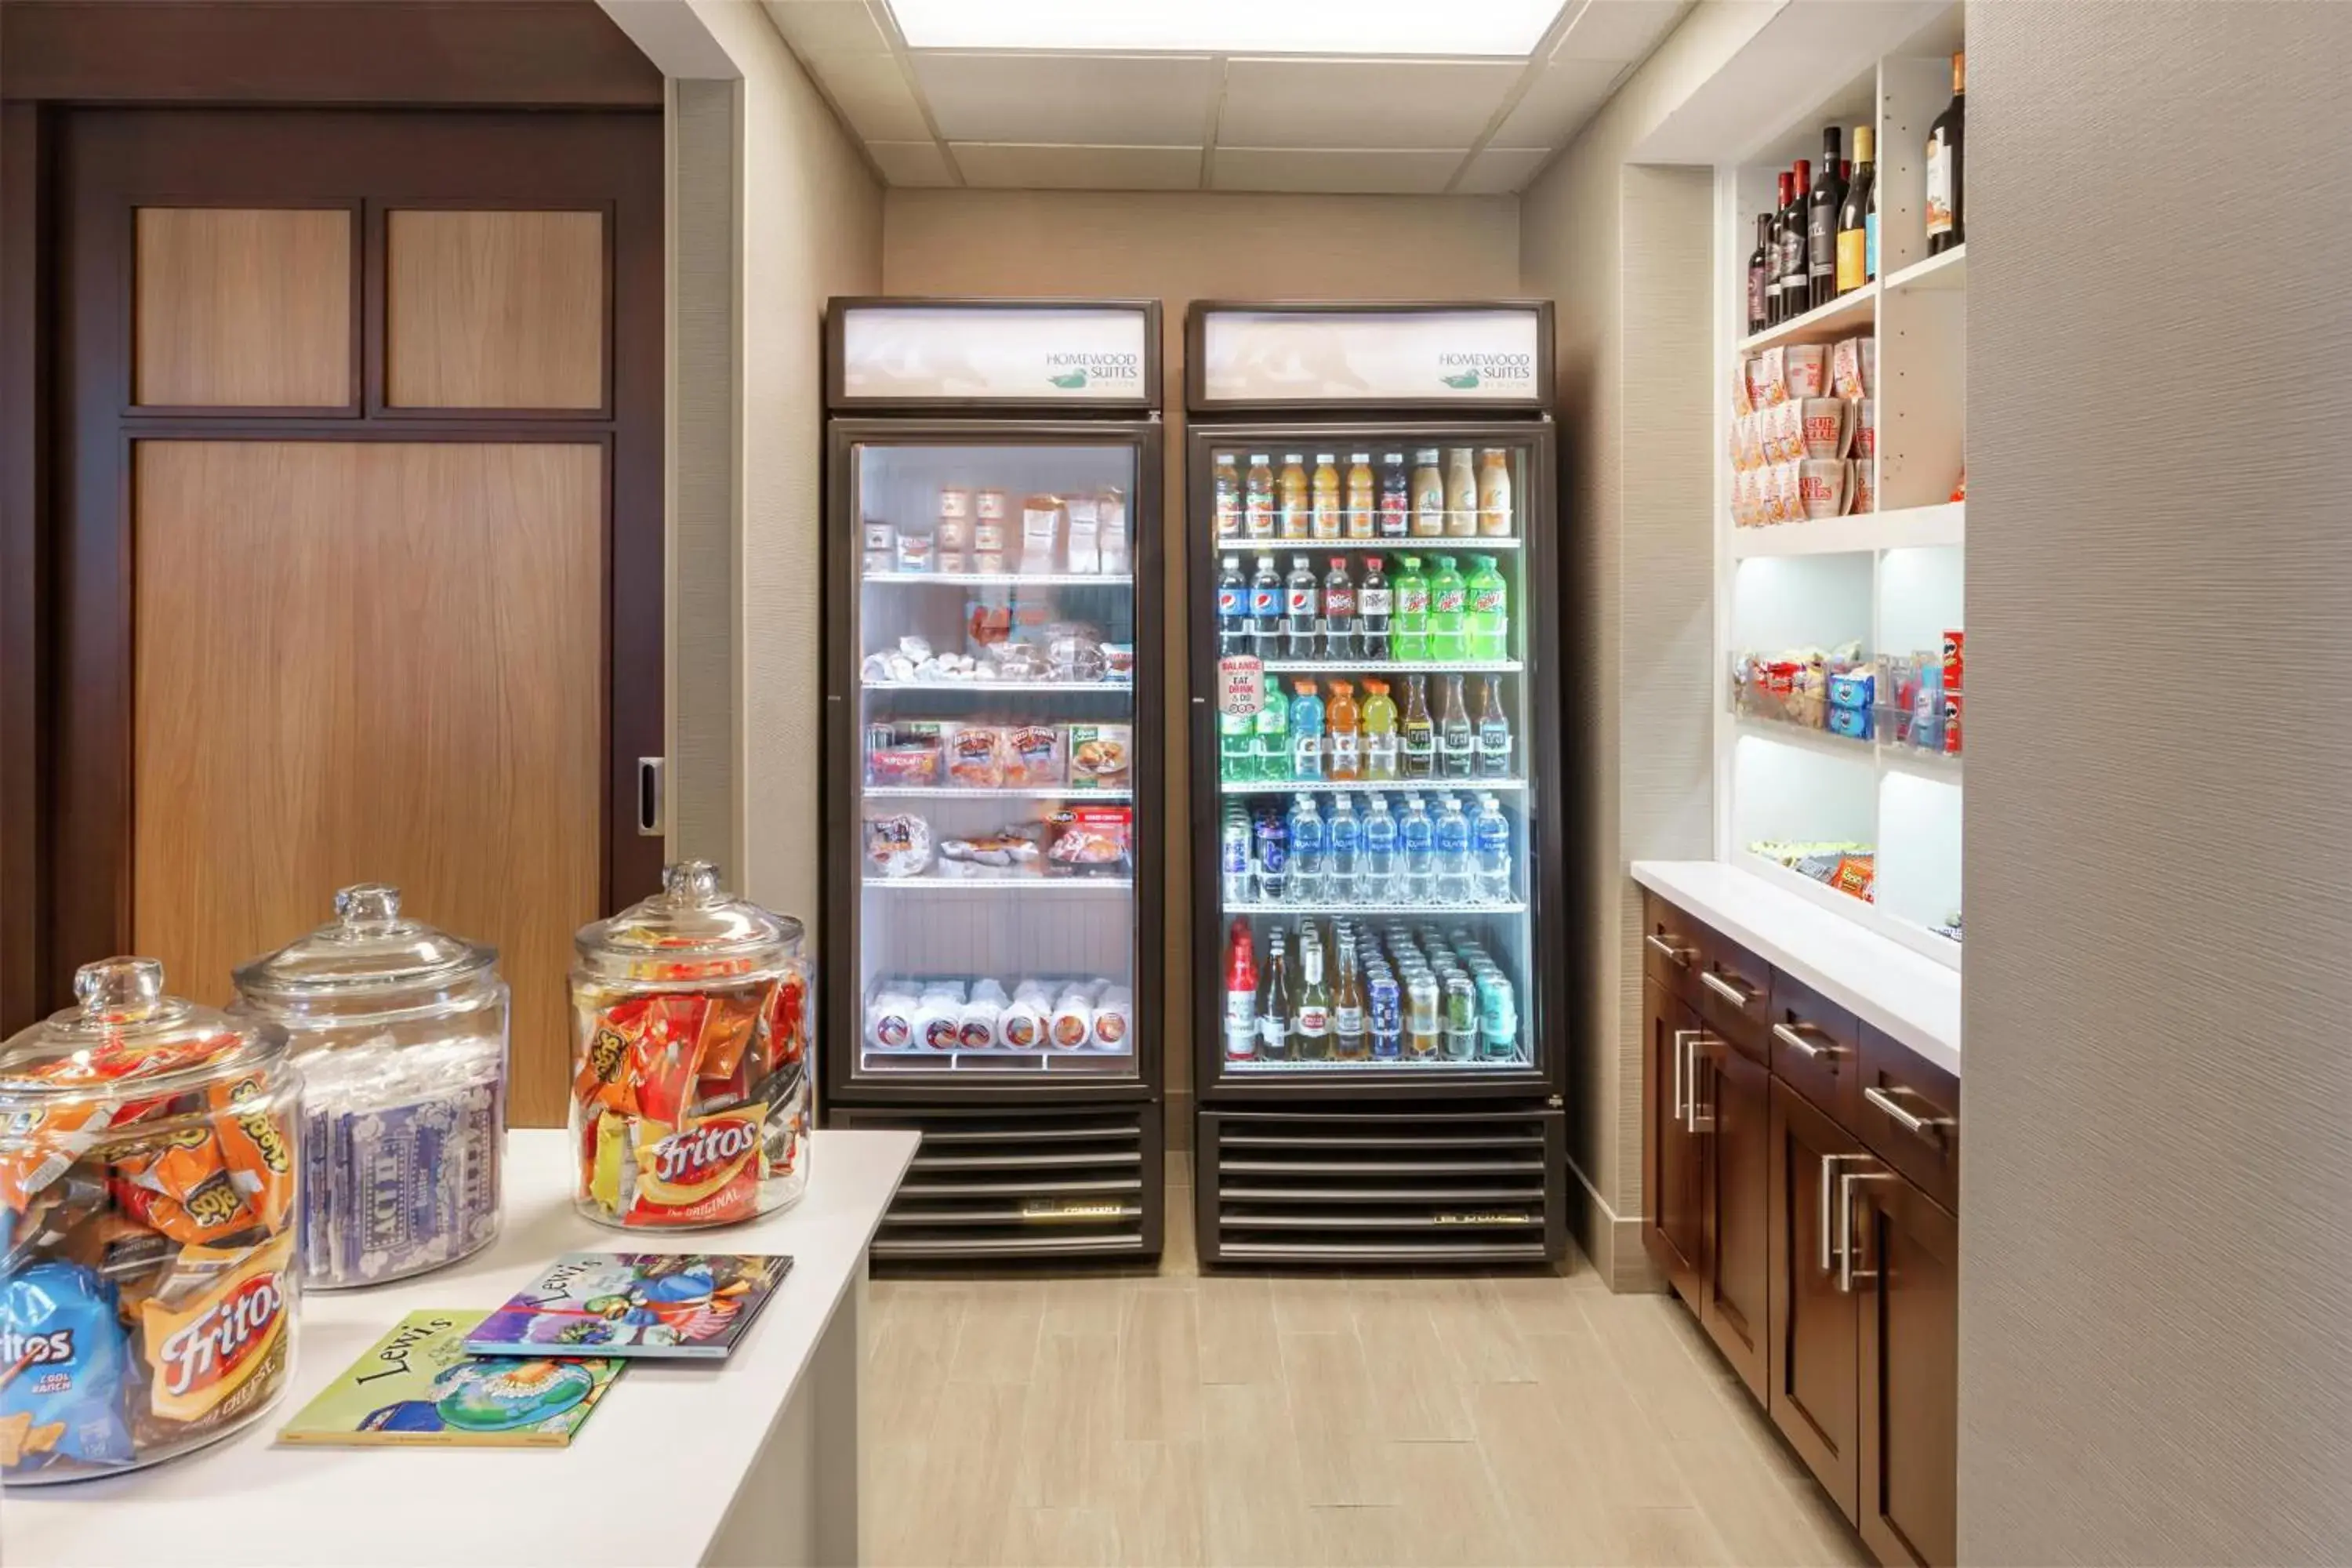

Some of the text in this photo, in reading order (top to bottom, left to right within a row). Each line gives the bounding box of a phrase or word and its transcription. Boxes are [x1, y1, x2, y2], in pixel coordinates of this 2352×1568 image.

[1046, 353, 1138, 366] HOMEWOOD
[1091, 366, 1138, 379] SUITES
[1439, 353, 1530, 366] HOMEWOOD
[1483, 366, 1530, 379] SUITES
[1233, 677, 1249, 685] EAT
[652, 1120, 757, 1181] Fritos
[374, 1188, 397, 1236] ACT
[524, 1261, 603, 1307] Lewis
[0, 1329, 73, 1363] itos
[161, 1272, 287, 1397] Fritos
[355, 1318, 452, 1385] Lewis
